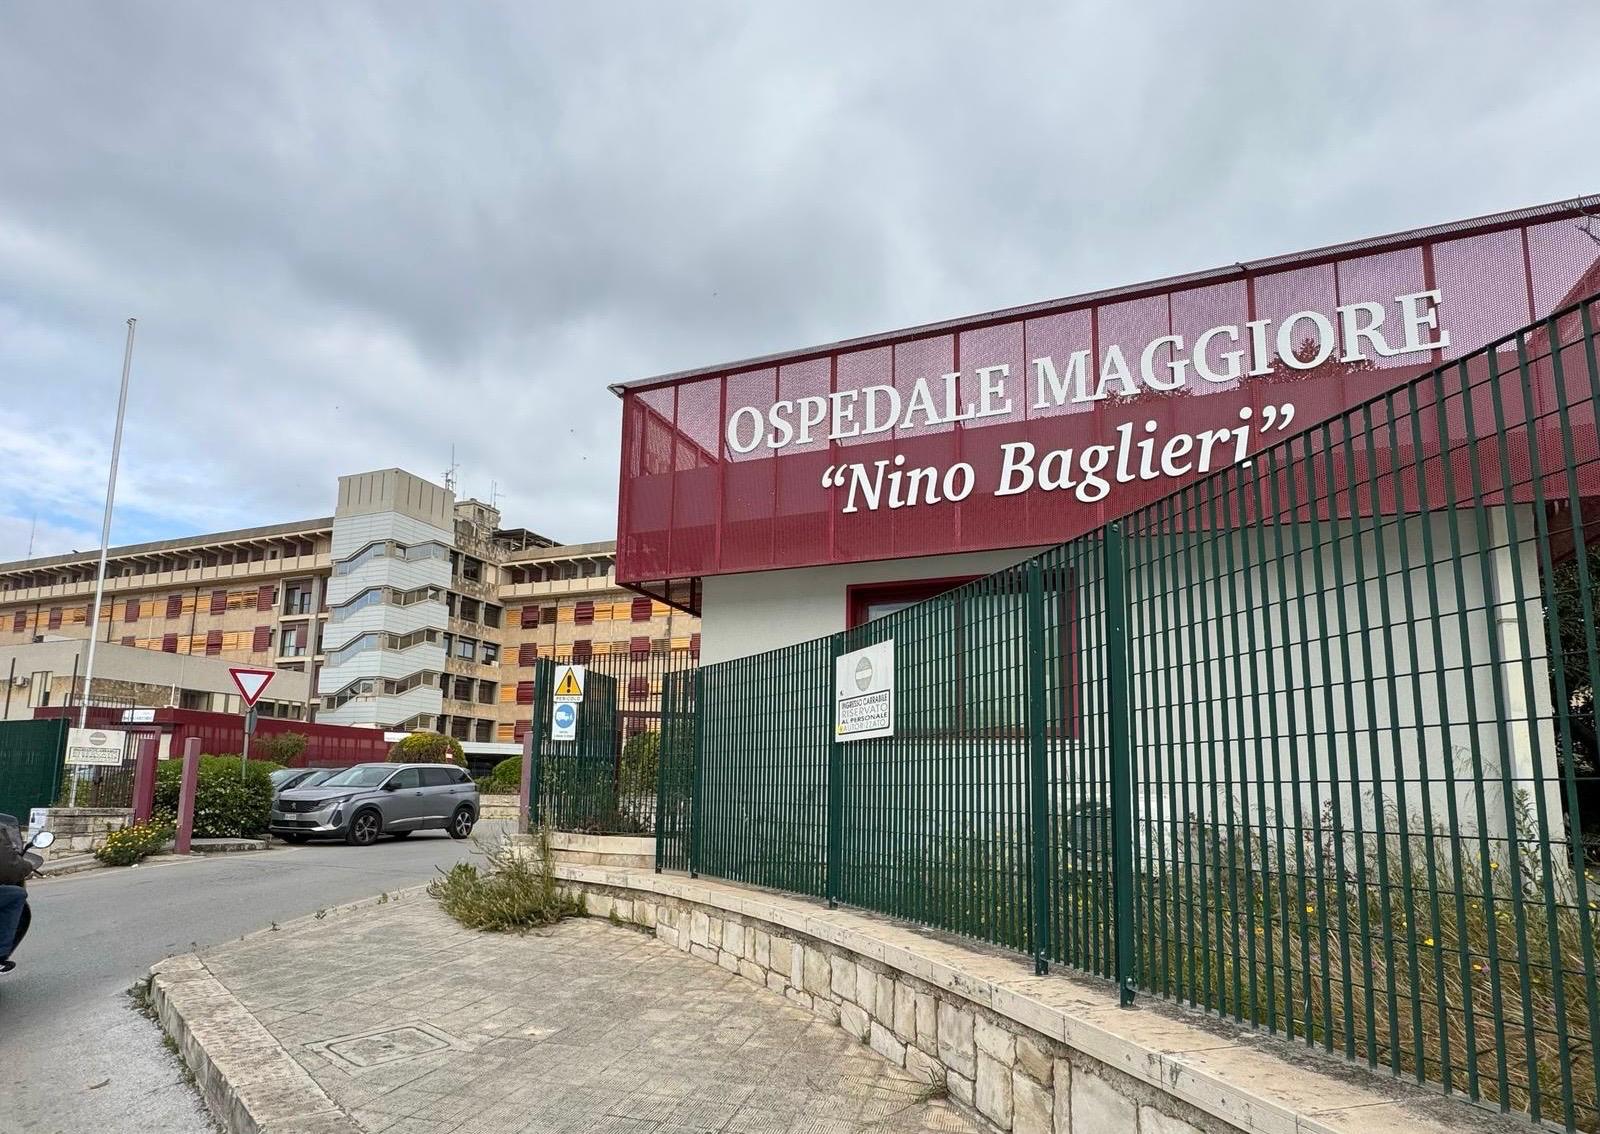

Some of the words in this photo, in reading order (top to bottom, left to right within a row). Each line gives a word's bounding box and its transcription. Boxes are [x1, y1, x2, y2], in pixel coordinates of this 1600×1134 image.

[727, 364, 1012, 453] OSPEDALE
[1032, 289, 1450, 408] MAGGIORE
[841, 702, 888, 718] RISERVATO
[850, 712, 887, 723] PERSONALE
